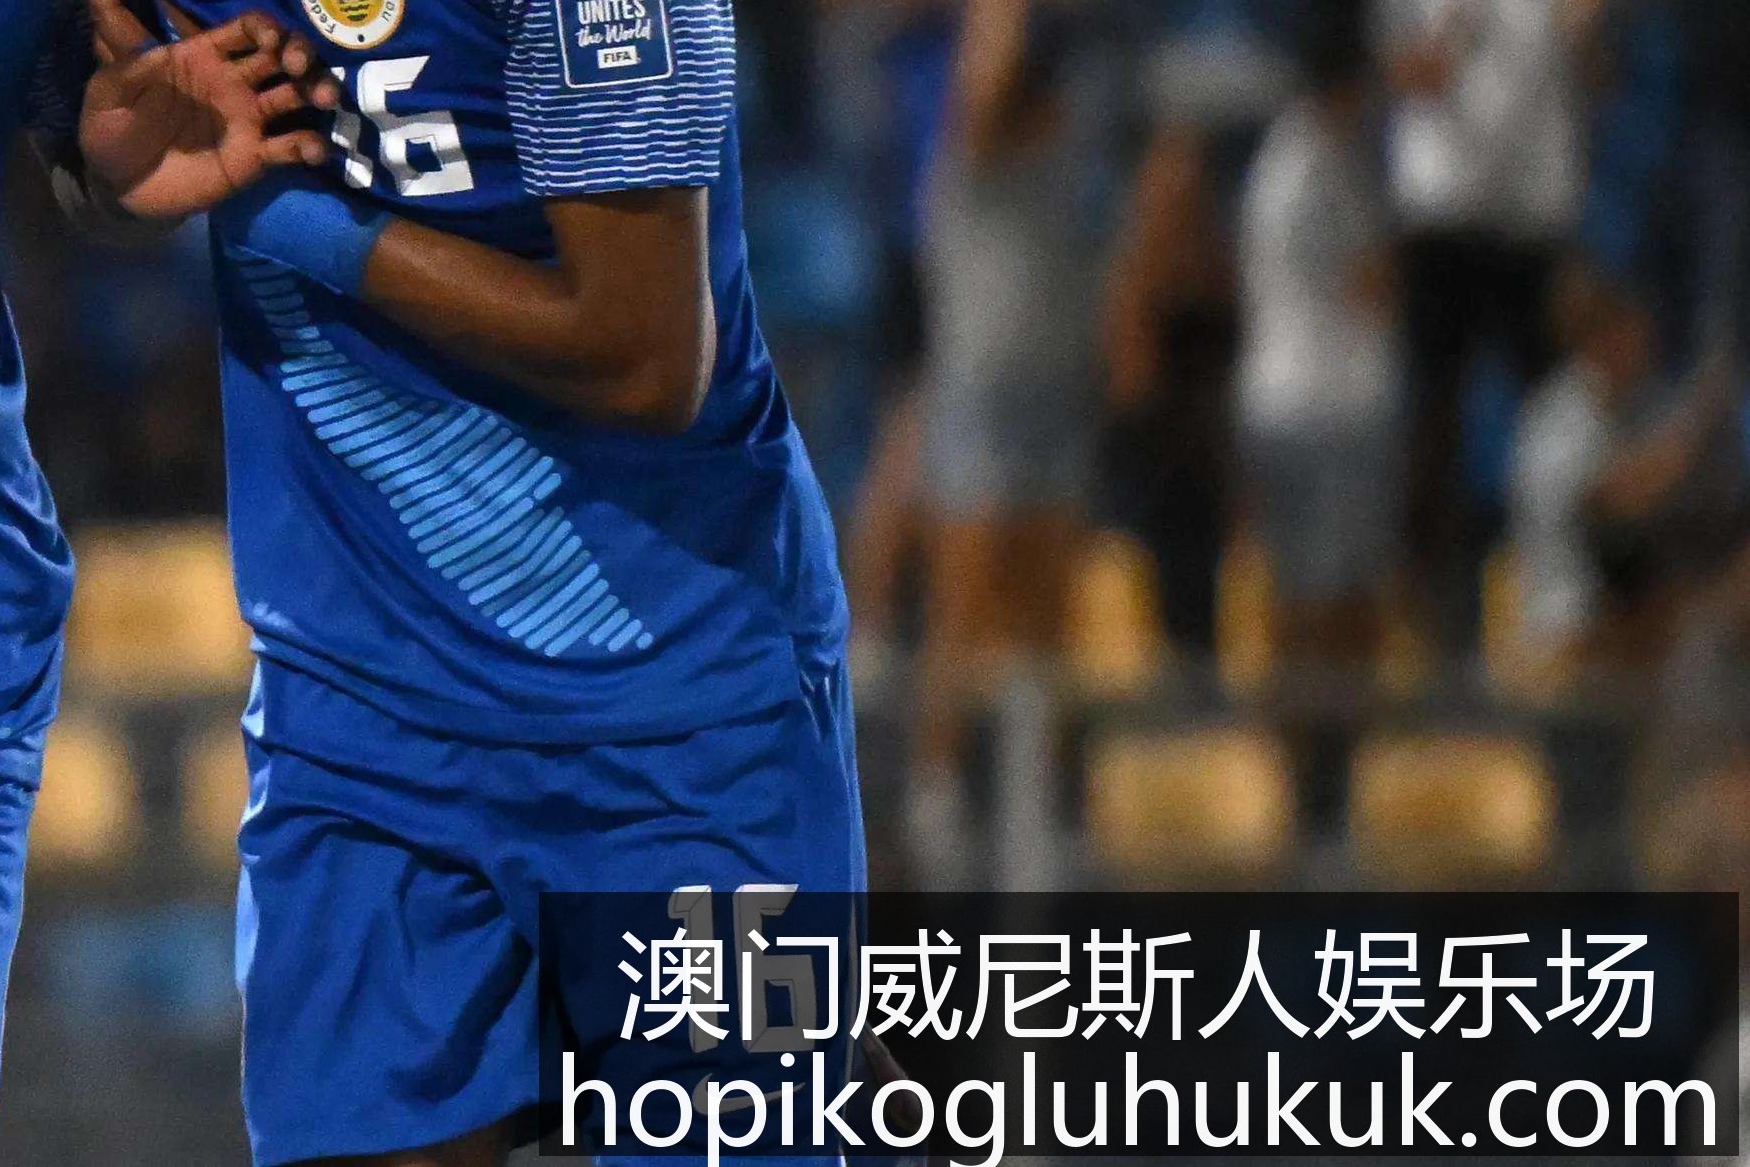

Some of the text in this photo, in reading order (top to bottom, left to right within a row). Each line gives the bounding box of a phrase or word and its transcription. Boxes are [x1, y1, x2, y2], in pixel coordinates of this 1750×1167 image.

[574, 18, 652, 48] the World
[603, 50, 633, 64] FIFA
[667, 883, 818, 1054] 16
